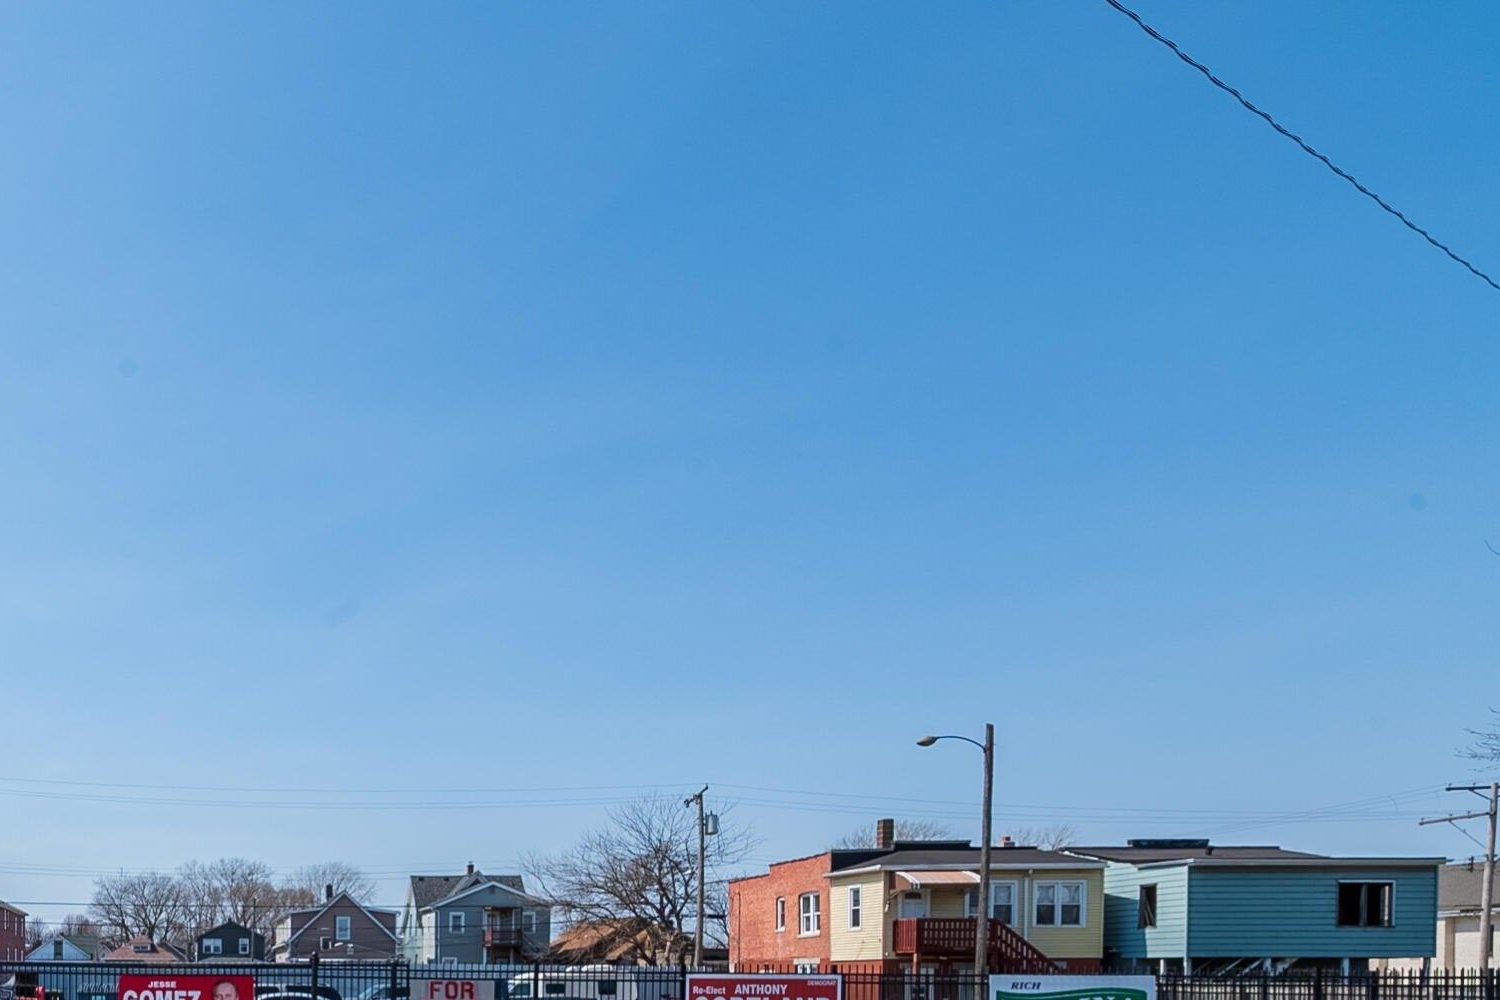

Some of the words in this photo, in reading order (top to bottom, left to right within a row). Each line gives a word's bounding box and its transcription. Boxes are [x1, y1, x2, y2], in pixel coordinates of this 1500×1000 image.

[147, 980, 177, 989] JESSE
[692, 986, 726, 995] Re-Elect
[734, 984, 788, 995] ANTHONY
[1010, 981, 1042, 990] RICH
[429, 981, 475, 1000] FOR
